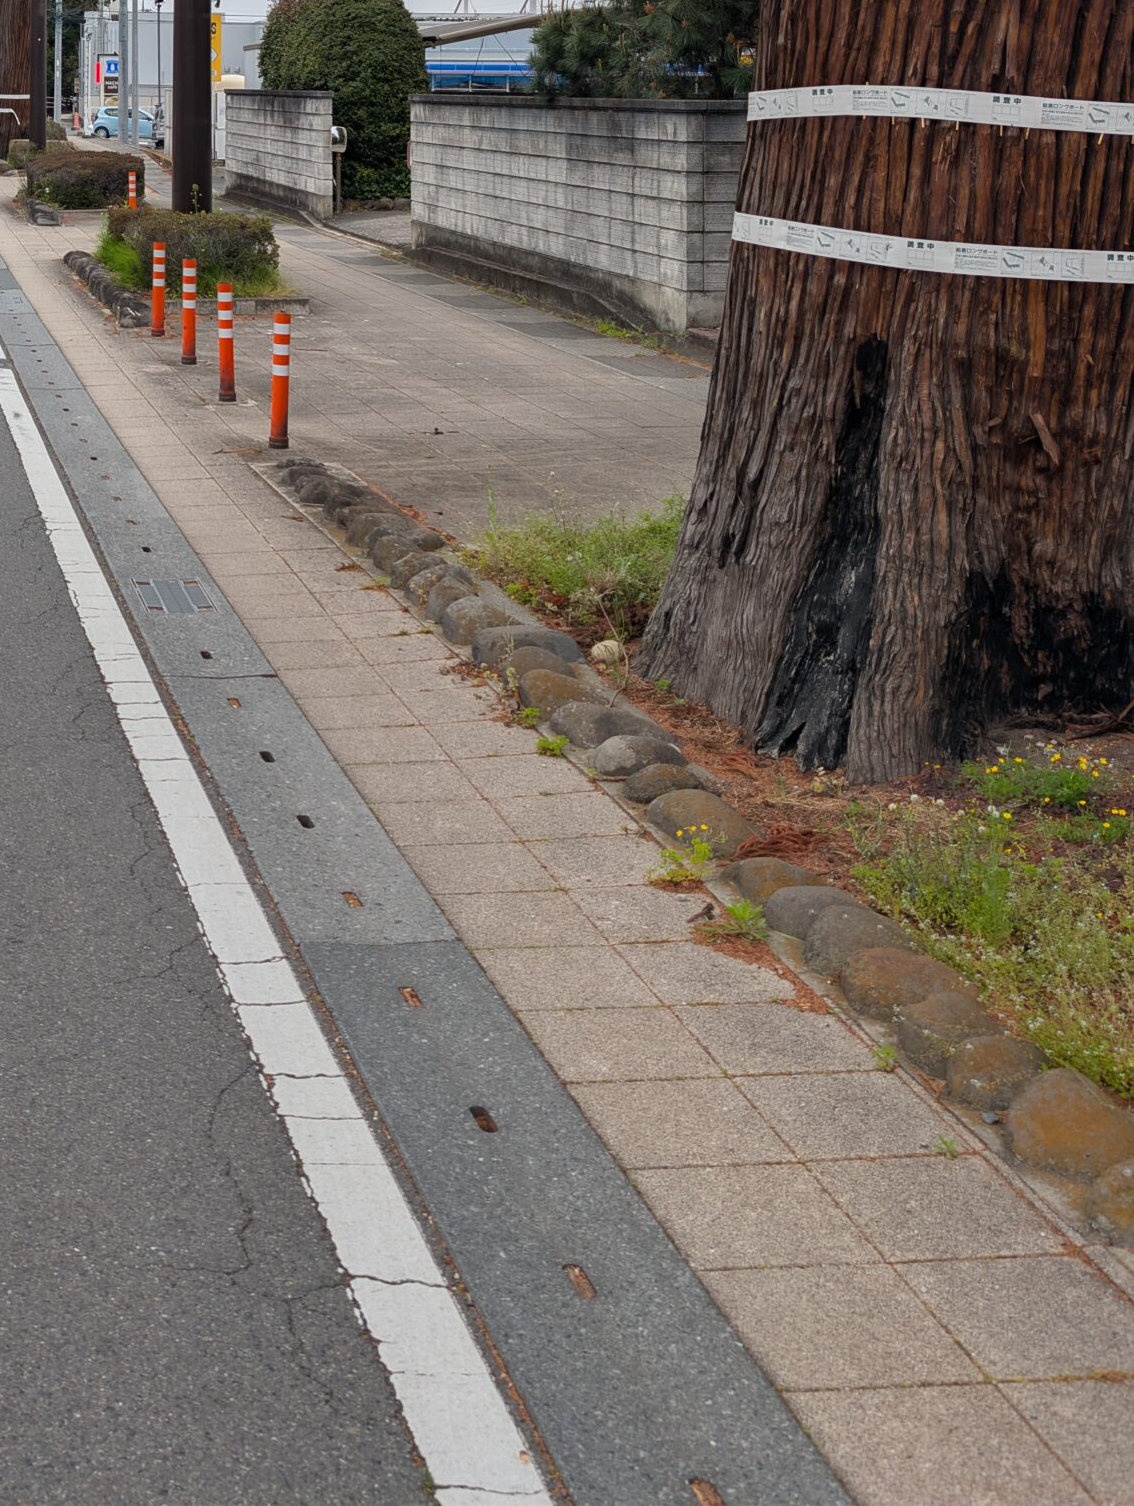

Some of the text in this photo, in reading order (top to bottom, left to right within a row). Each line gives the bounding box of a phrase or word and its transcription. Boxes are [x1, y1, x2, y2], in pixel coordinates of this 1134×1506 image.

[993, 96, 1021, 105] 調査中
[907, 241, 935, 250] 調査中
